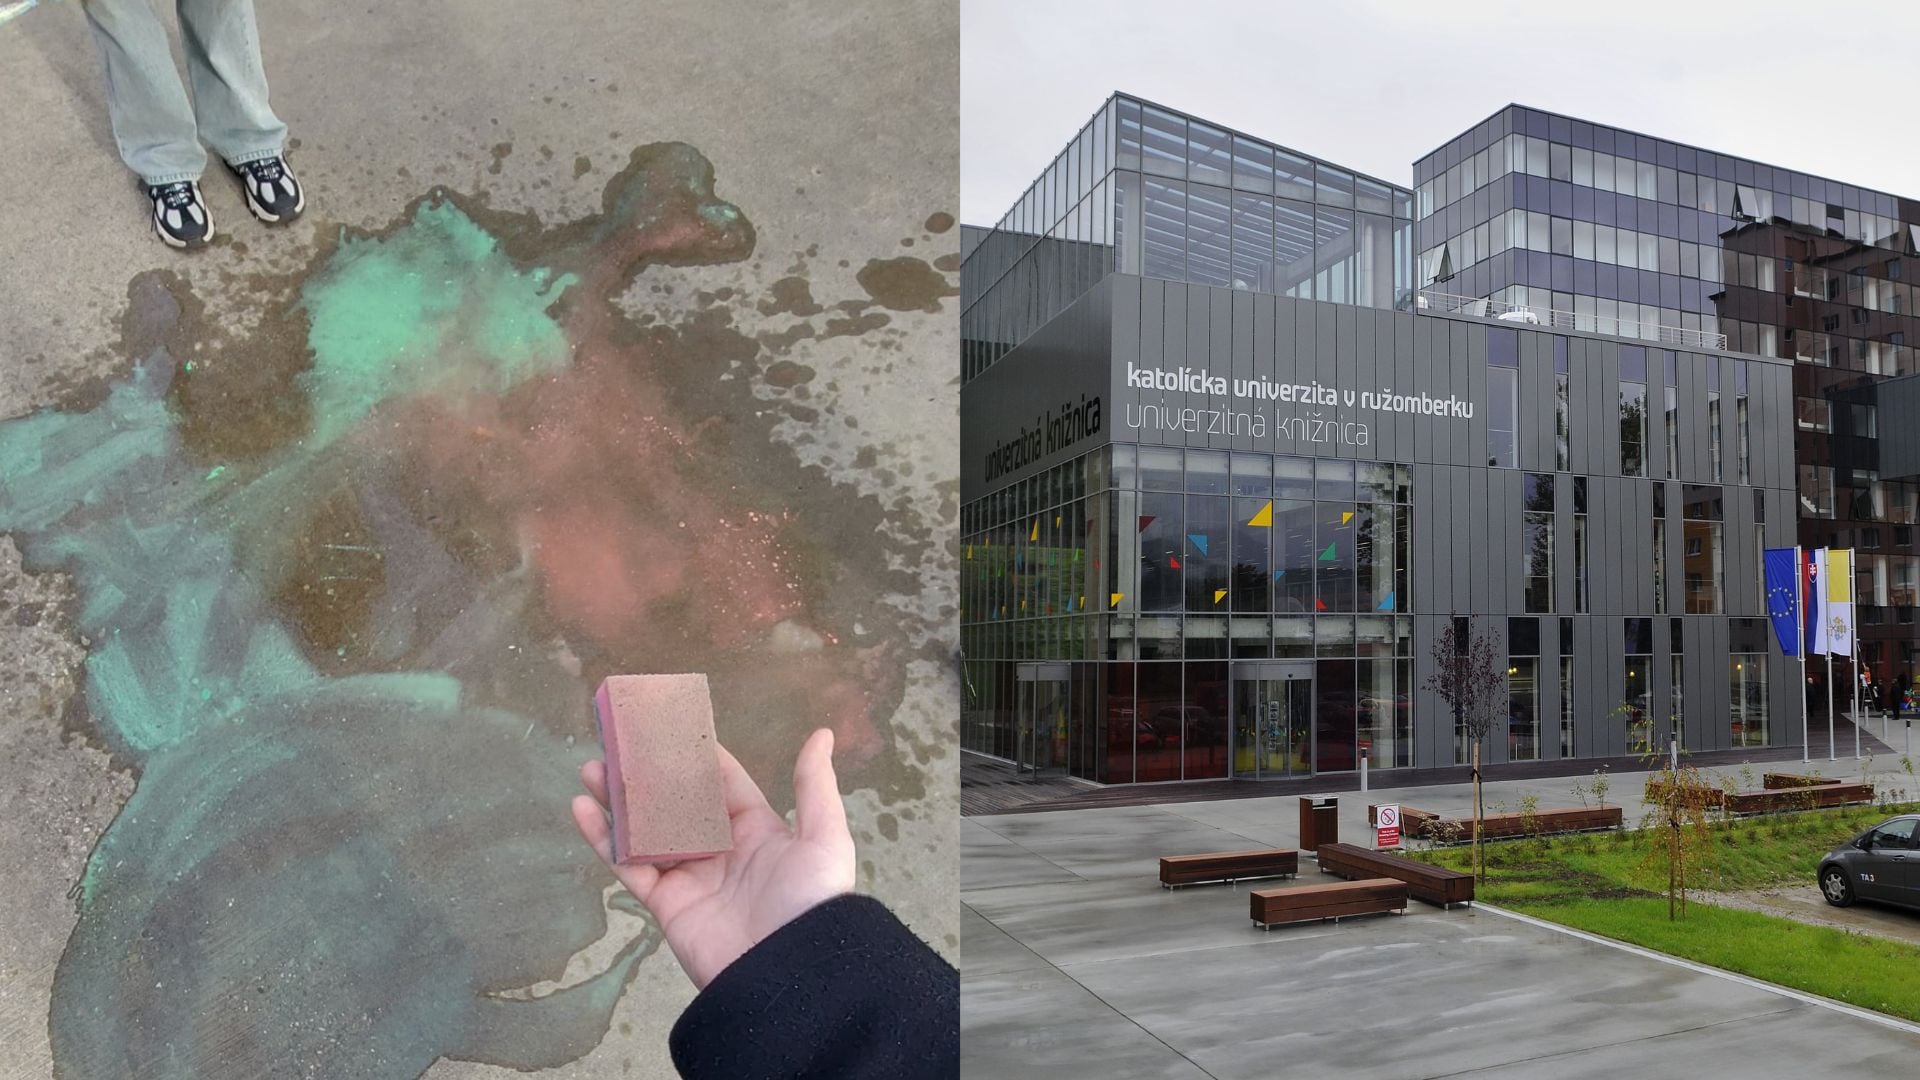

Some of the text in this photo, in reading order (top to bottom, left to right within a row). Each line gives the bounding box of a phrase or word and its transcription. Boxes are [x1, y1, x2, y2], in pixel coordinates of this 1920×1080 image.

[1127, 361, 1474, 419] katolícka univerzita v ružomberku
[985, 393, 1101, 483] univerzitná knižnica
[1126, 398, 1369, 446] univerzitná knižnica
